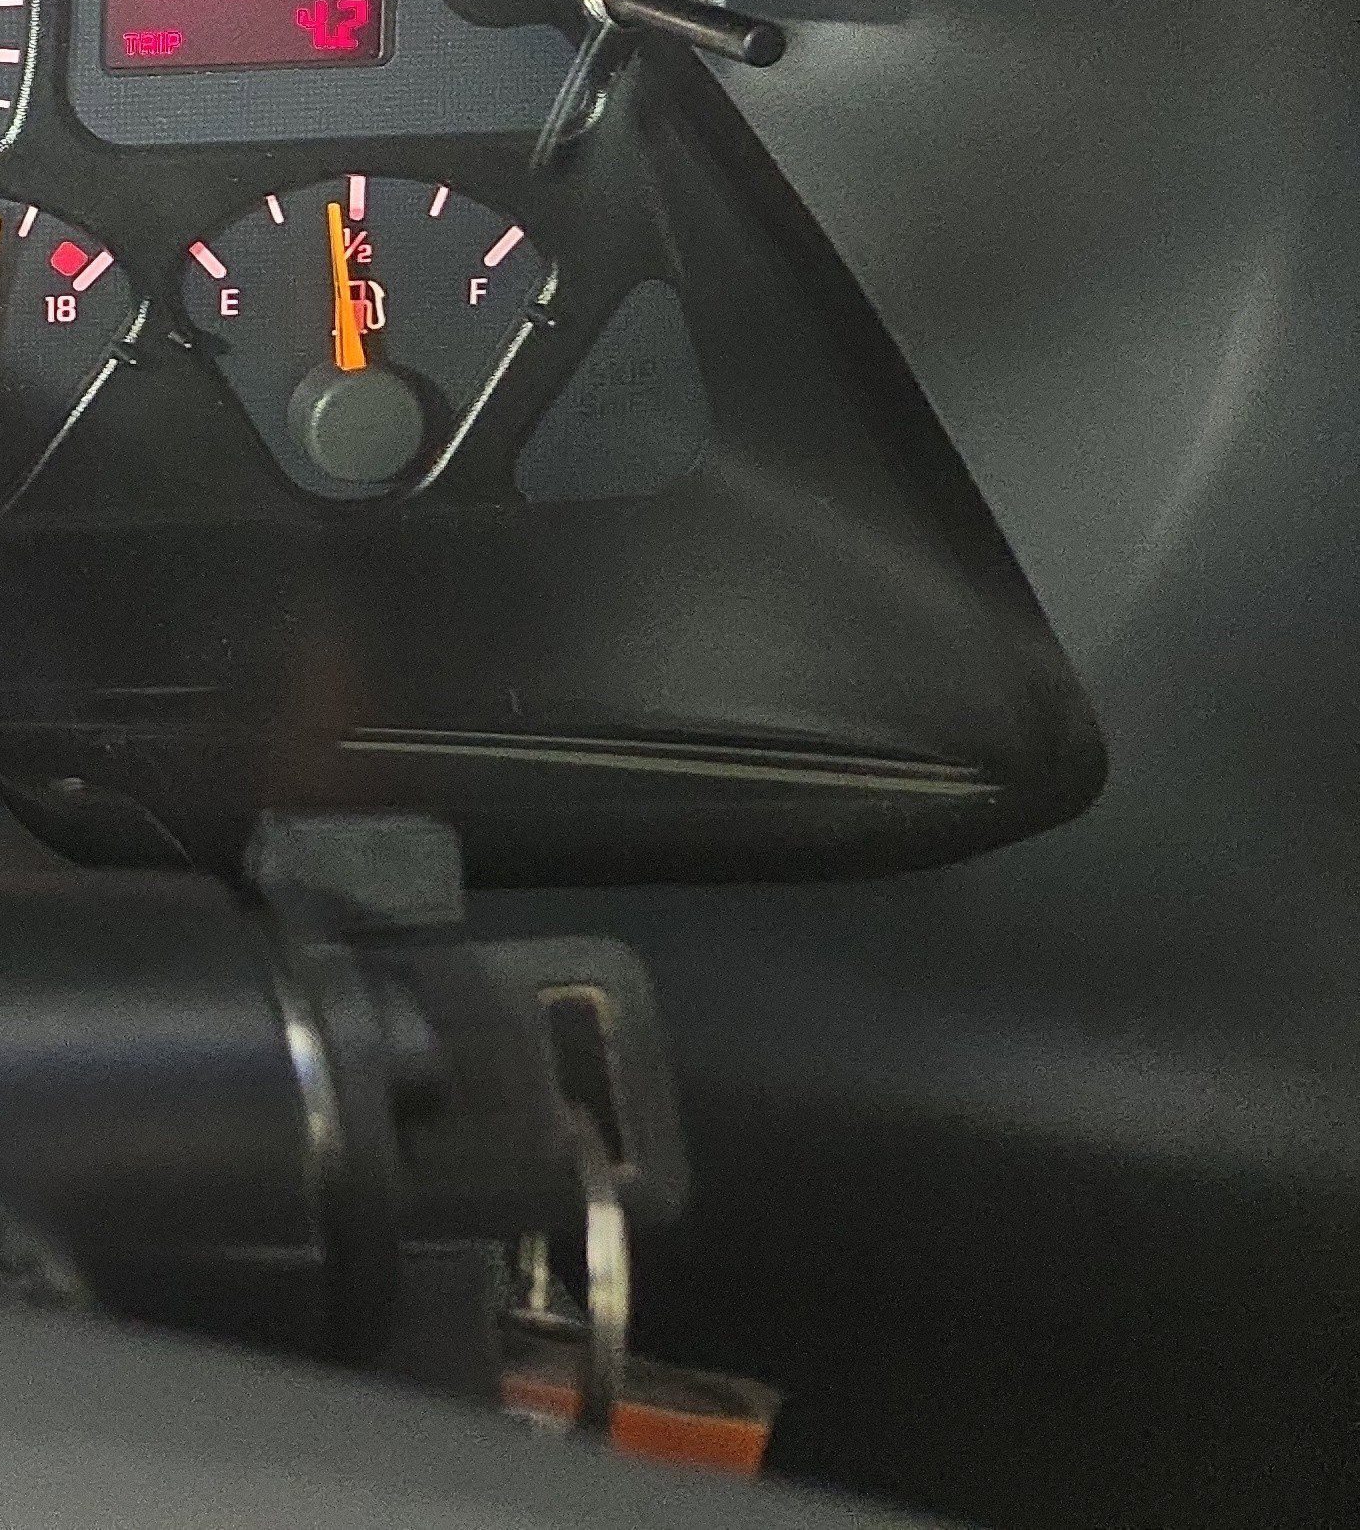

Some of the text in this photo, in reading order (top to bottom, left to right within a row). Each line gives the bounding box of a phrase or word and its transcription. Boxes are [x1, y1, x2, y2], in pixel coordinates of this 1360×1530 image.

[123, 32, 182, 55] TRIP
[221, 289, 239, 315] E
[470, 278, 487, 304] F
[46, 296, 75, 322] 18
